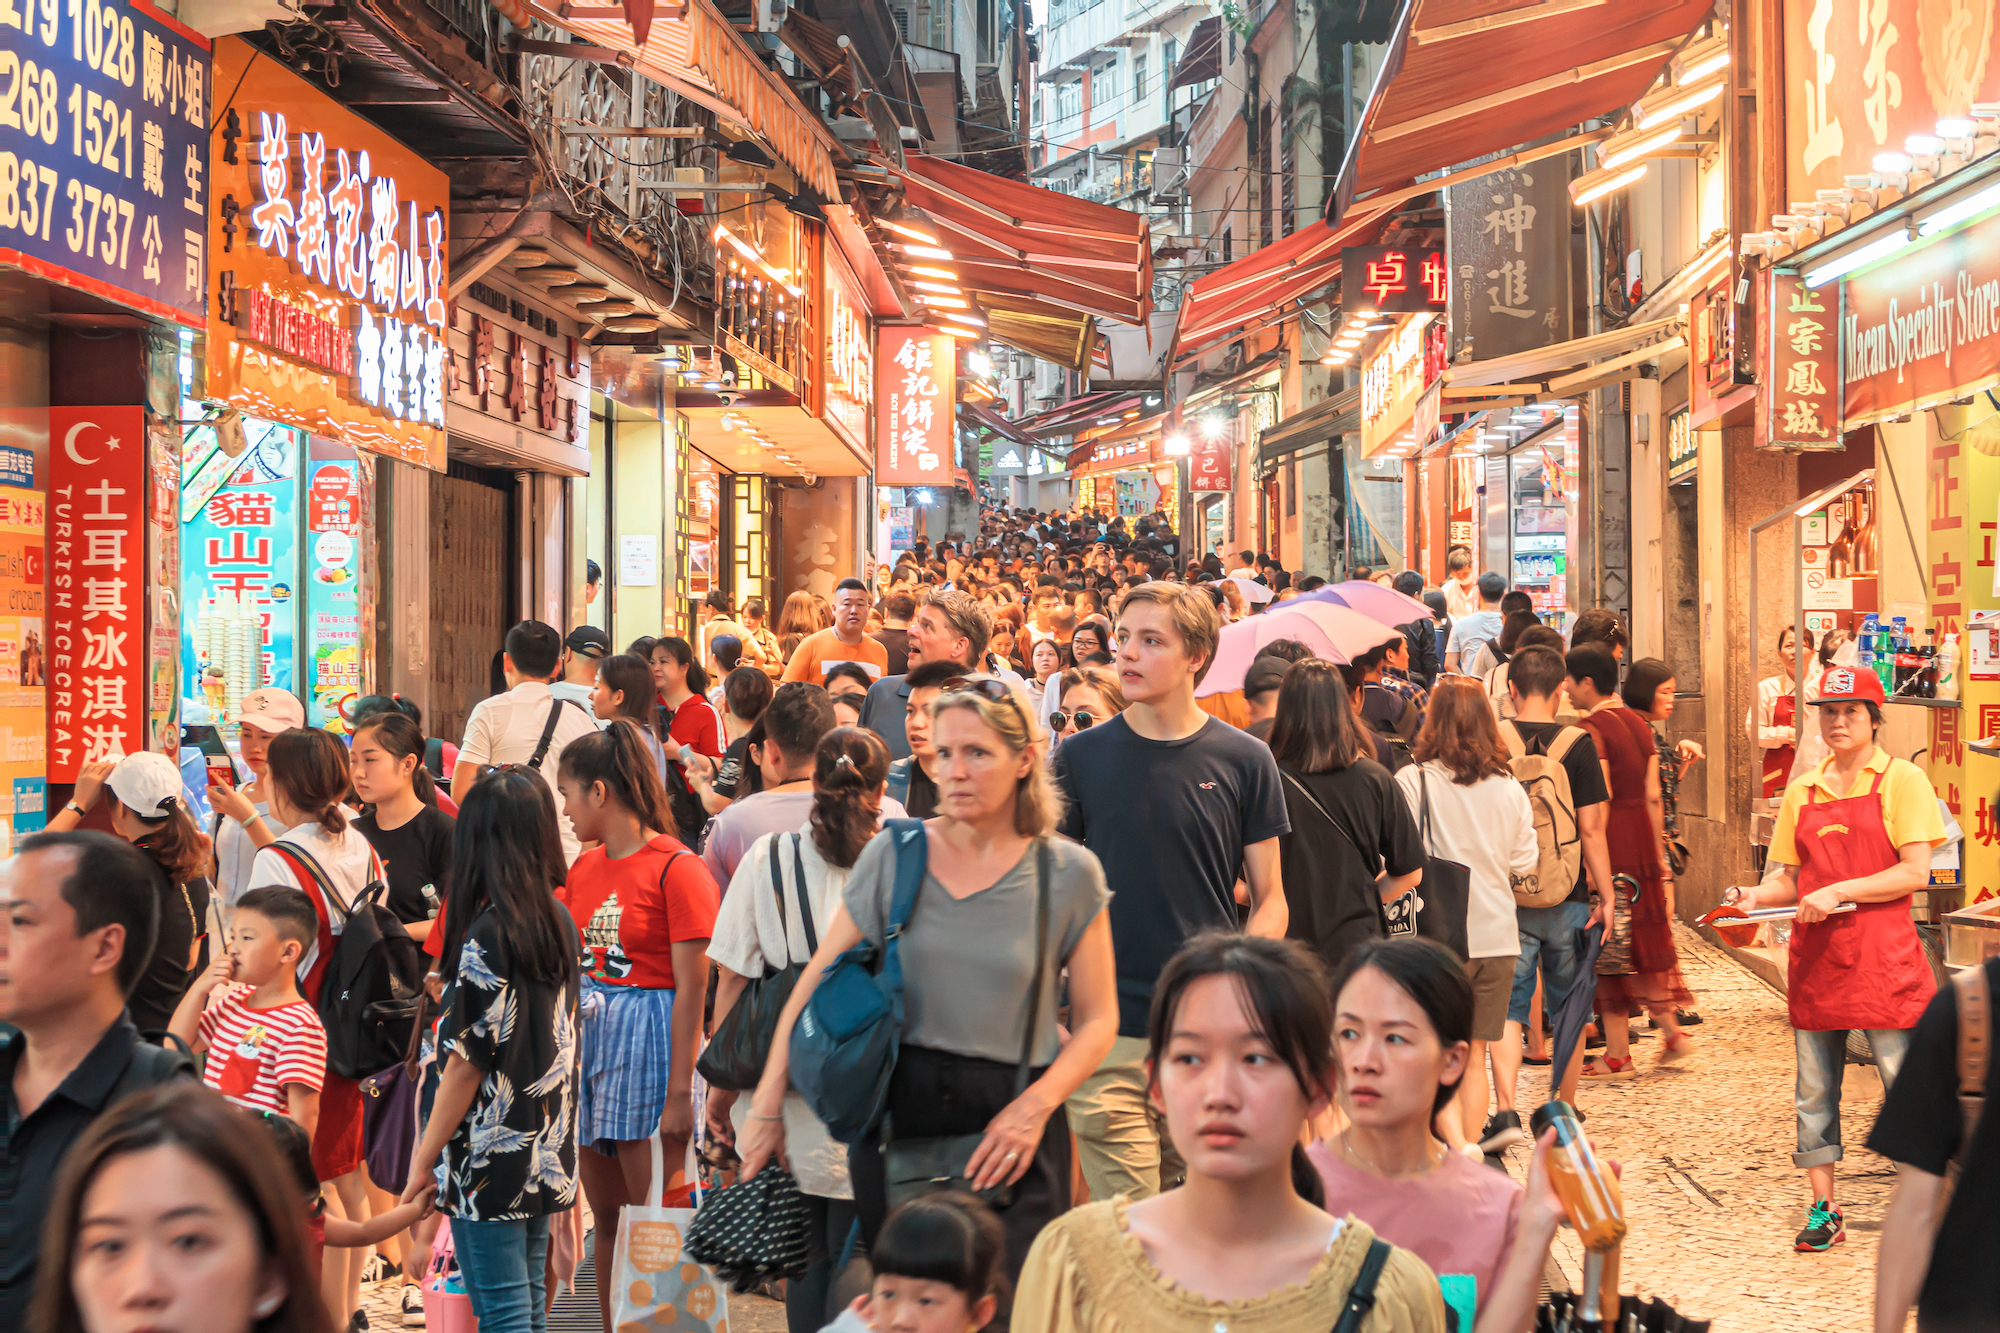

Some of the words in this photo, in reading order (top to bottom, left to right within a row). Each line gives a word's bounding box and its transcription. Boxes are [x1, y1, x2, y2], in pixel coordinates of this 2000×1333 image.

[68, 0, 135, 87] 1028
[142, 29, 204, 130] 陳小姐
[68, 83, 132, 179] 1521
[65, 178, 135, 270] 3737
[1783, 282, 1829, 438] 正宗鳳城
[1845, 313, 1887, 384] Macau
[1888, 281, 1954, 384] Specialty
[1956, 269, 2000, 346] Store
[890, 393, 899, 407] KOI
[890, 409, 899, 425] KEI
[893, 338, 939, 456] 鉅記餅家
[890, 426, 899, 470] BAKERY
[55, 484, 72, 608] TURKISH
[81, 478, 128, 764] 土耳其冰淇淋
[55, 620, 72, 765] ICECREAM
[1381, 676, 1401, 690] GA
